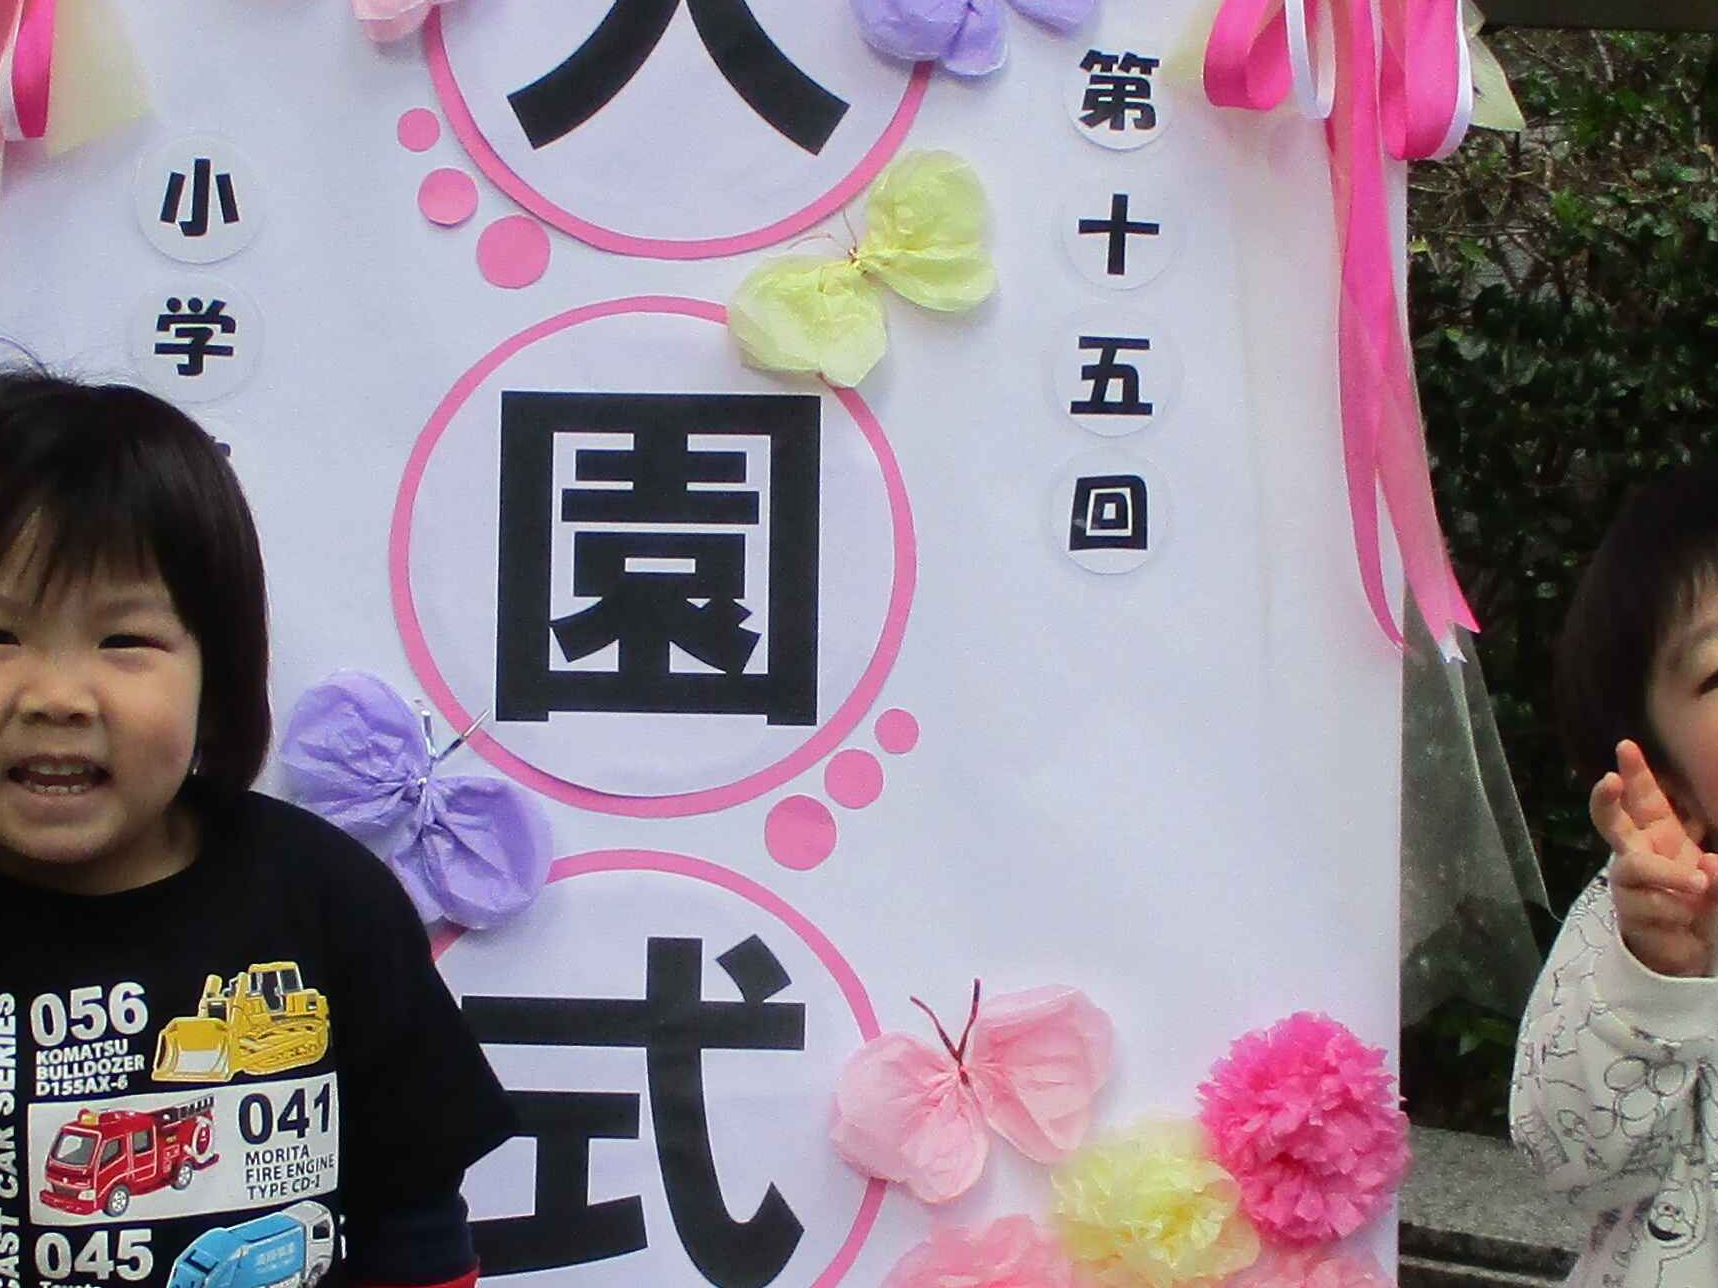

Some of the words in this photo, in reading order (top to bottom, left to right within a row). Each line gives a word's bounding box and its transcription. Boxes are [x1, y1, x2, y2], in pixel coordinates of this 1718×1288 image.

[152, 158, 240, 457] 小学
[1068, 49, 1160, 552] 第十五回
[30, 982, 150, 1047] 056
[35, 1038, 129, 1066] KOMATSU
[35, 1054, 146, 1081] BULLDOZER
[35, 1074, 129, 1098] D155AX-6
[238, 1082, 331, 1145] 041
[244, 1143, 310, 1167] MORITA
[245, 1163, 282, 1185] FIRE
[285, 1153, 336, 1180] ENGINE
[246, 1179, 288, 1201] TYPE
[34, 1227, 154, 1282] 045
